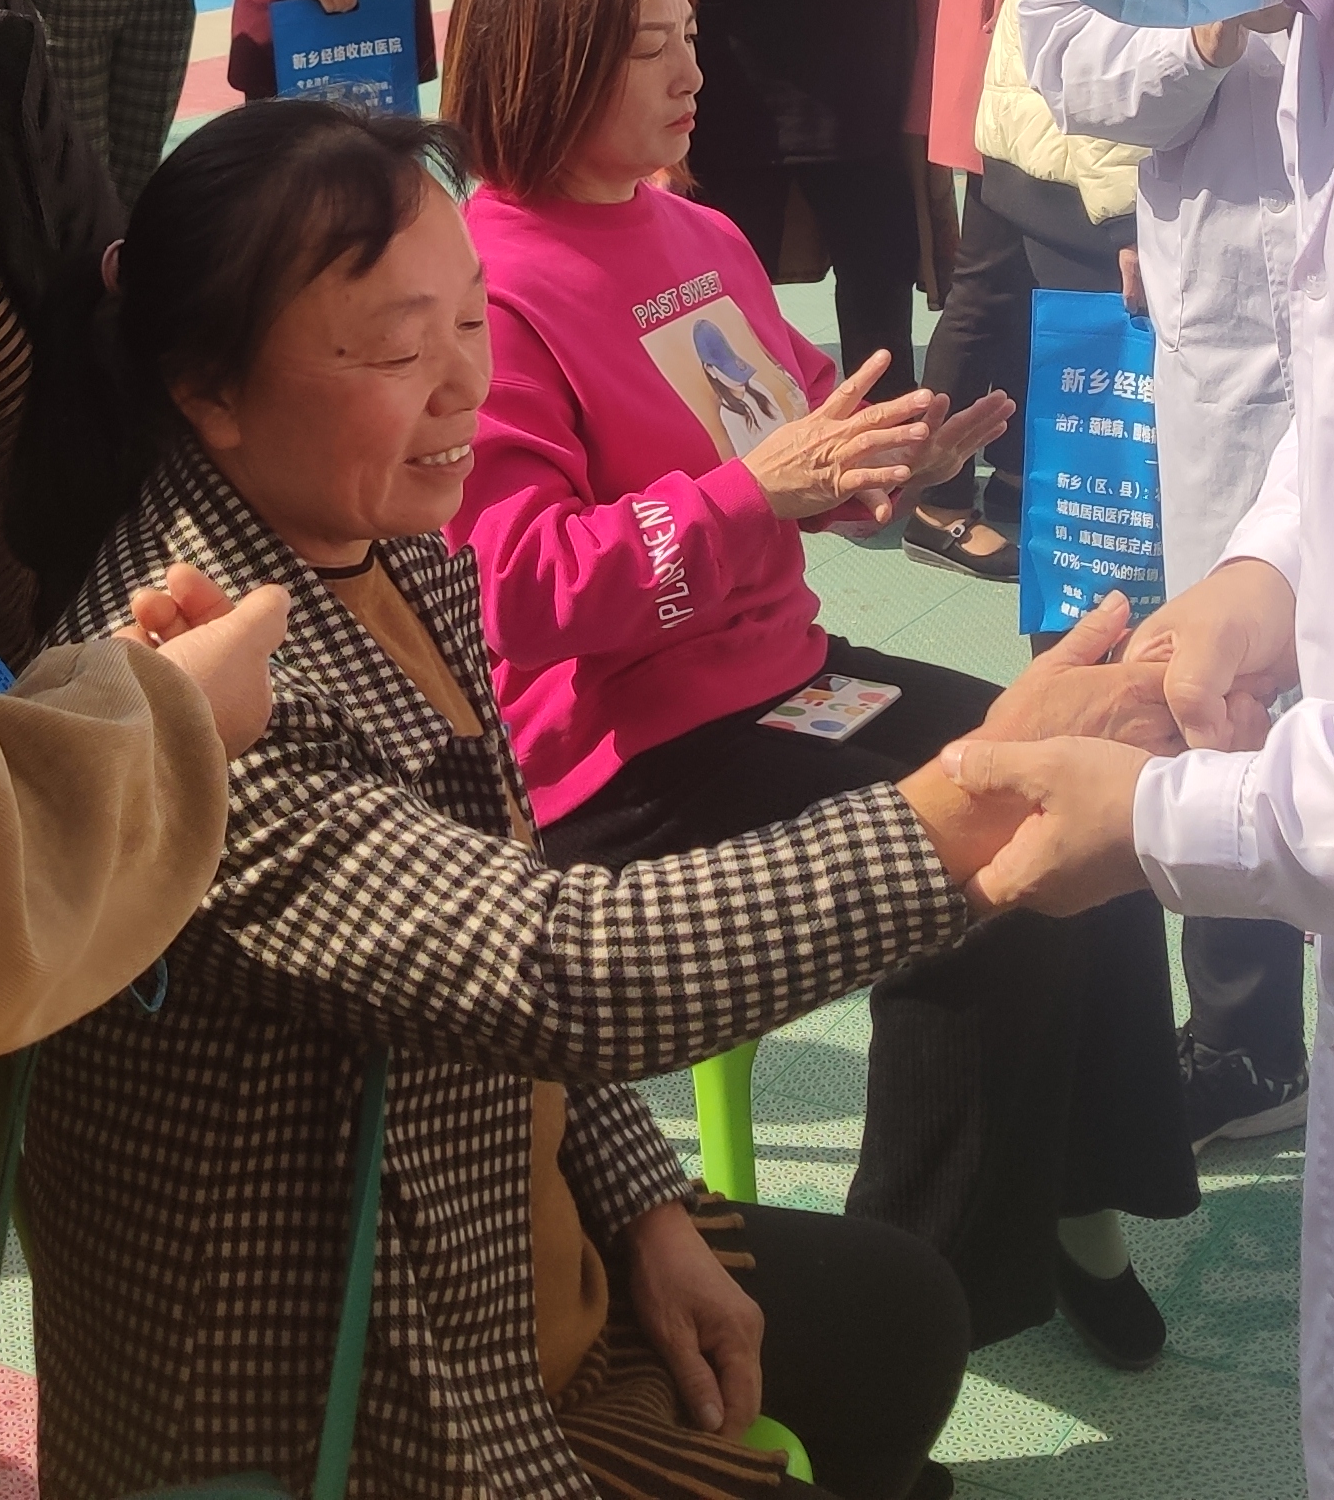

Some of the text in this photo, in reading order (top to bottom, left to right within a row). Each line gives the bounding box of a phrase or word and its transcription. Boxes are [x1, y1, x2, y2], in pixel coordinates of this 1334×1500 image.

[292, 37, 403, 70] 新乡经络收放医院
[632, 270, 723, 328] PAST SWEET
[1061, 366, 1155, 404] 新乡经络
